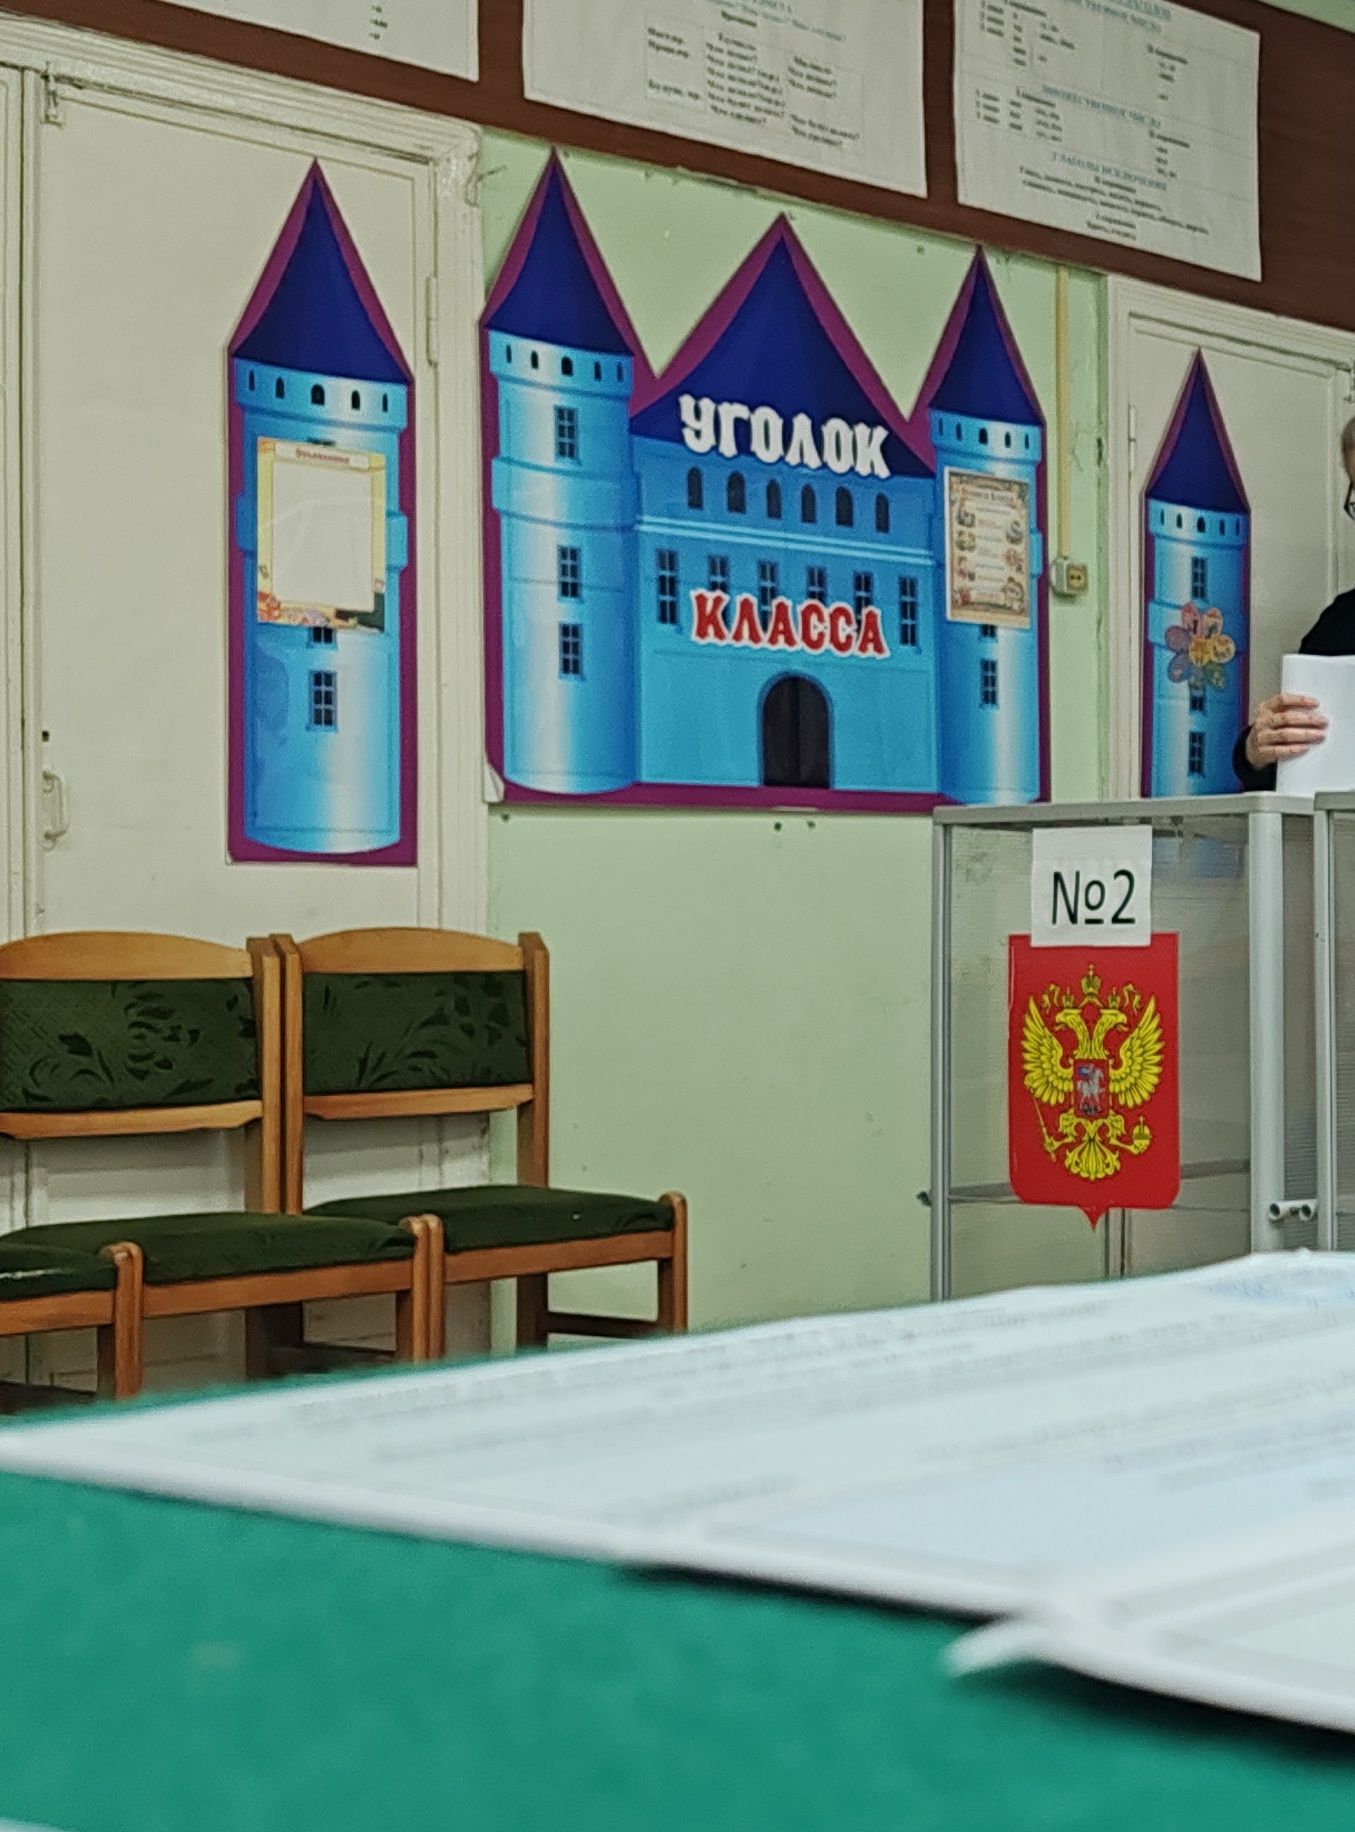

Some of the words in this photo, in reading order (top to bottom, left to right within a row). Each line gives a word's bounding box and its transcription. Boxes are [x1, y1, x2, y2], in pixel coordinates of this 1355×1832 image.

[678, 393, 891, 479] УГОЛОК
[690, 588, 891, 660] КЛАССА
[1052, 869, 1136, 925] №2
